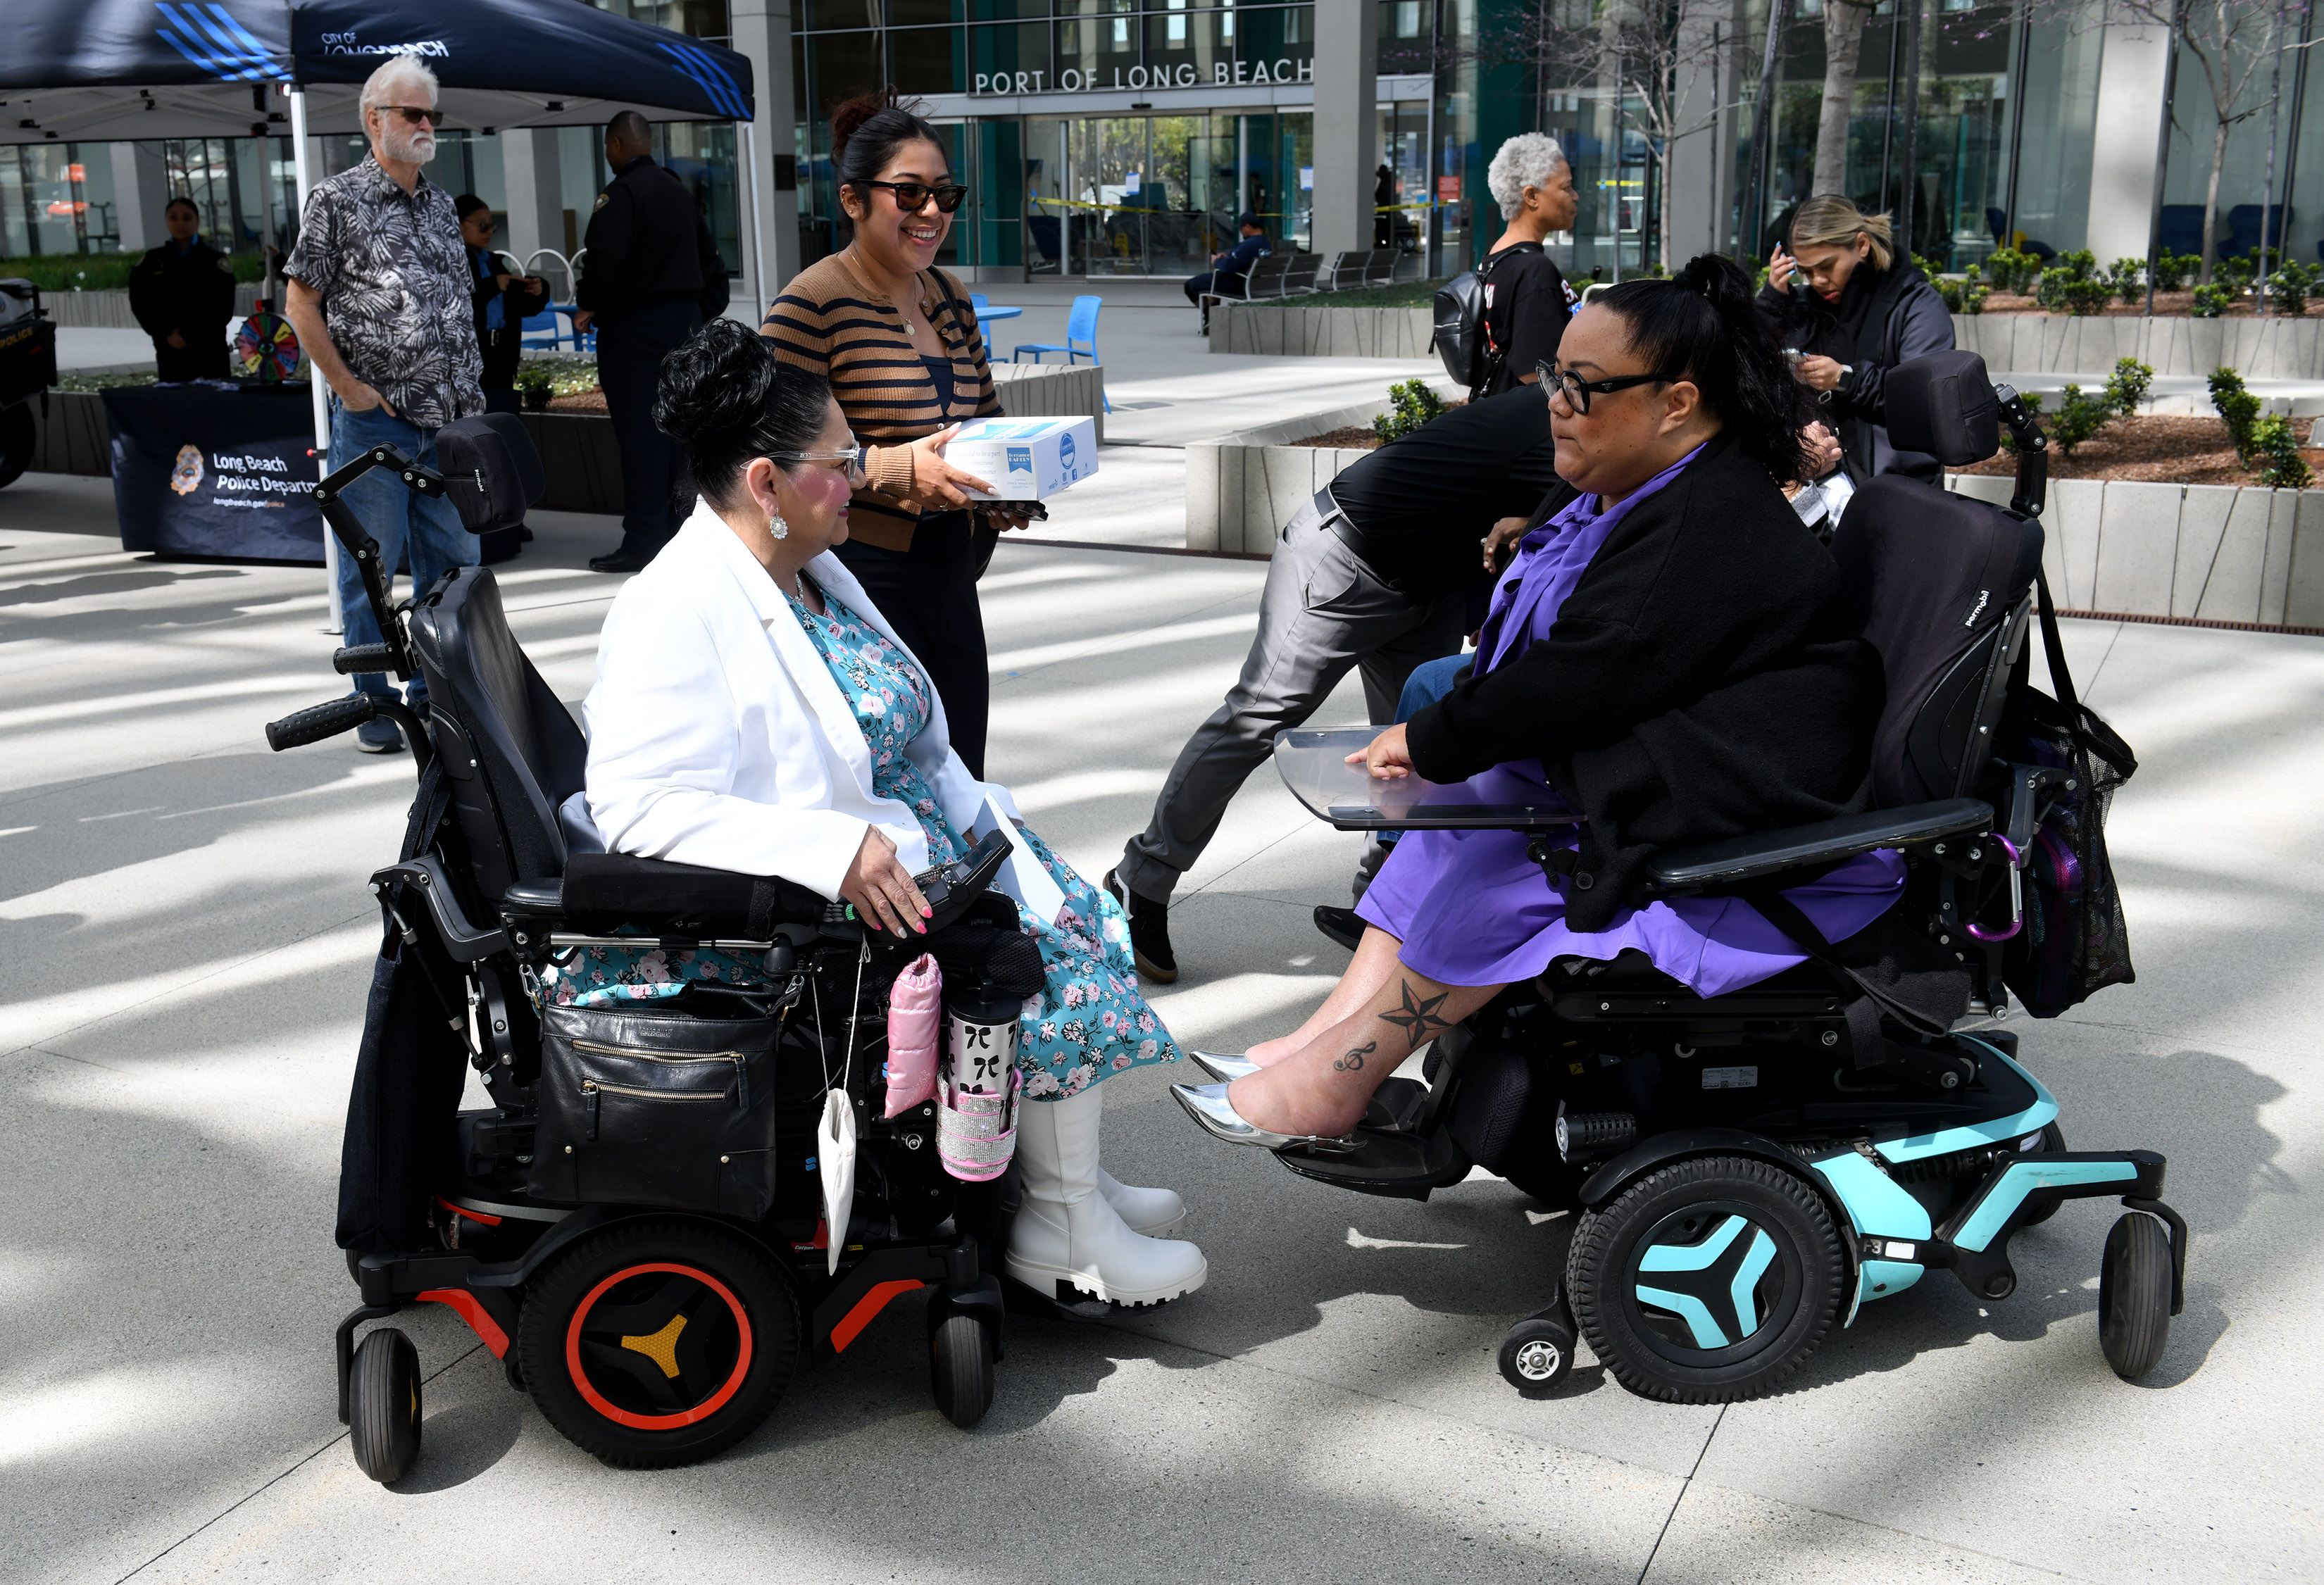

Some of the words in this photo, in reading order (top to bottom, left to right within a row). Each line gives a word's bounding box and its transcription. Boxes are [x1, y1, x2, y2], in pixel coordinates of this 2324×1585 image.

[321, 32, 342, 44] CITY
[343, 32, 357, 44] OF
[975, 70, 1044, 96] PORT
[1061, 68, 1097, 92] OF
[1114, 63, 1197, 90] LONG
[1214, 58, 1314, 86] BEACH
[0, 327, 33, 349] POLICE
[213, 453, 247, 473] Long
[244, 455, 288, 472] Beach
[216, 475, 260, 491] Police
[1965, 590, 1989, 627] permobil
